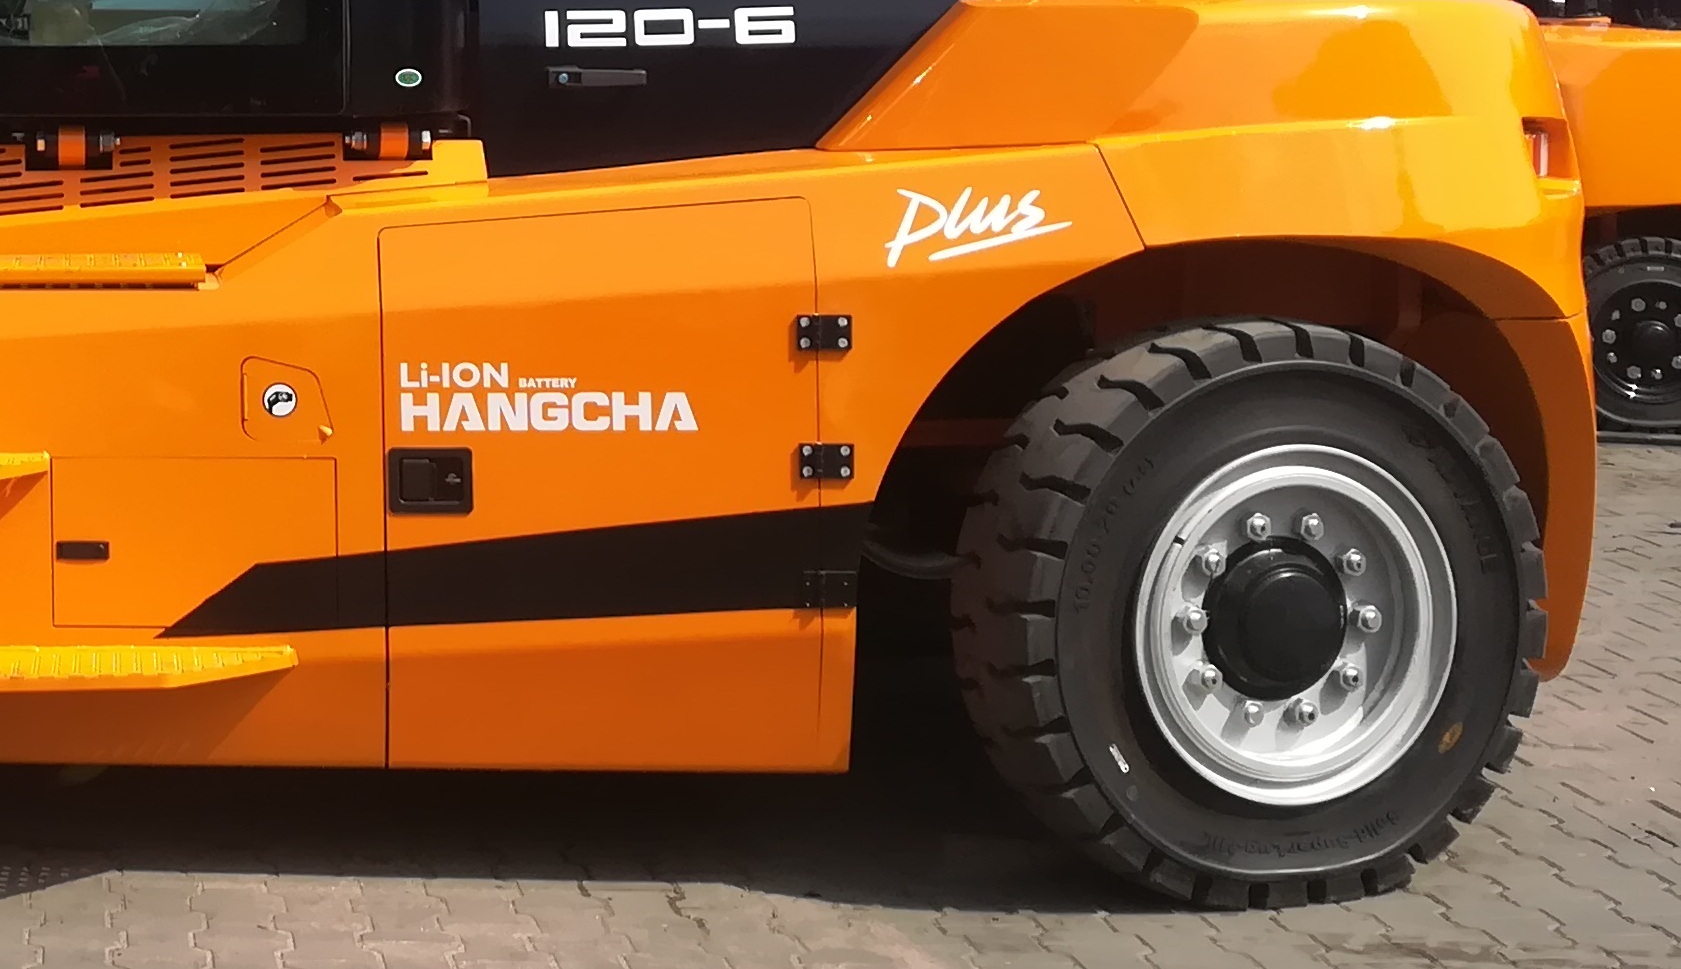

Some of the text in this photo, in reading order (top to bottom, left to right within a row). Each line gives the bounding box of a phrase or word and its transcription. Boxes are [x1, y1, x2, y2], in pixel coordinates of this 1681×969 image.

[544, 6, 796, 47] 120-6
[885, 186, 1072, 268] Plus
[400, 362, 577, 389] Li-ION BATTERY
[400, 391, 698, 431] HANGCHA
